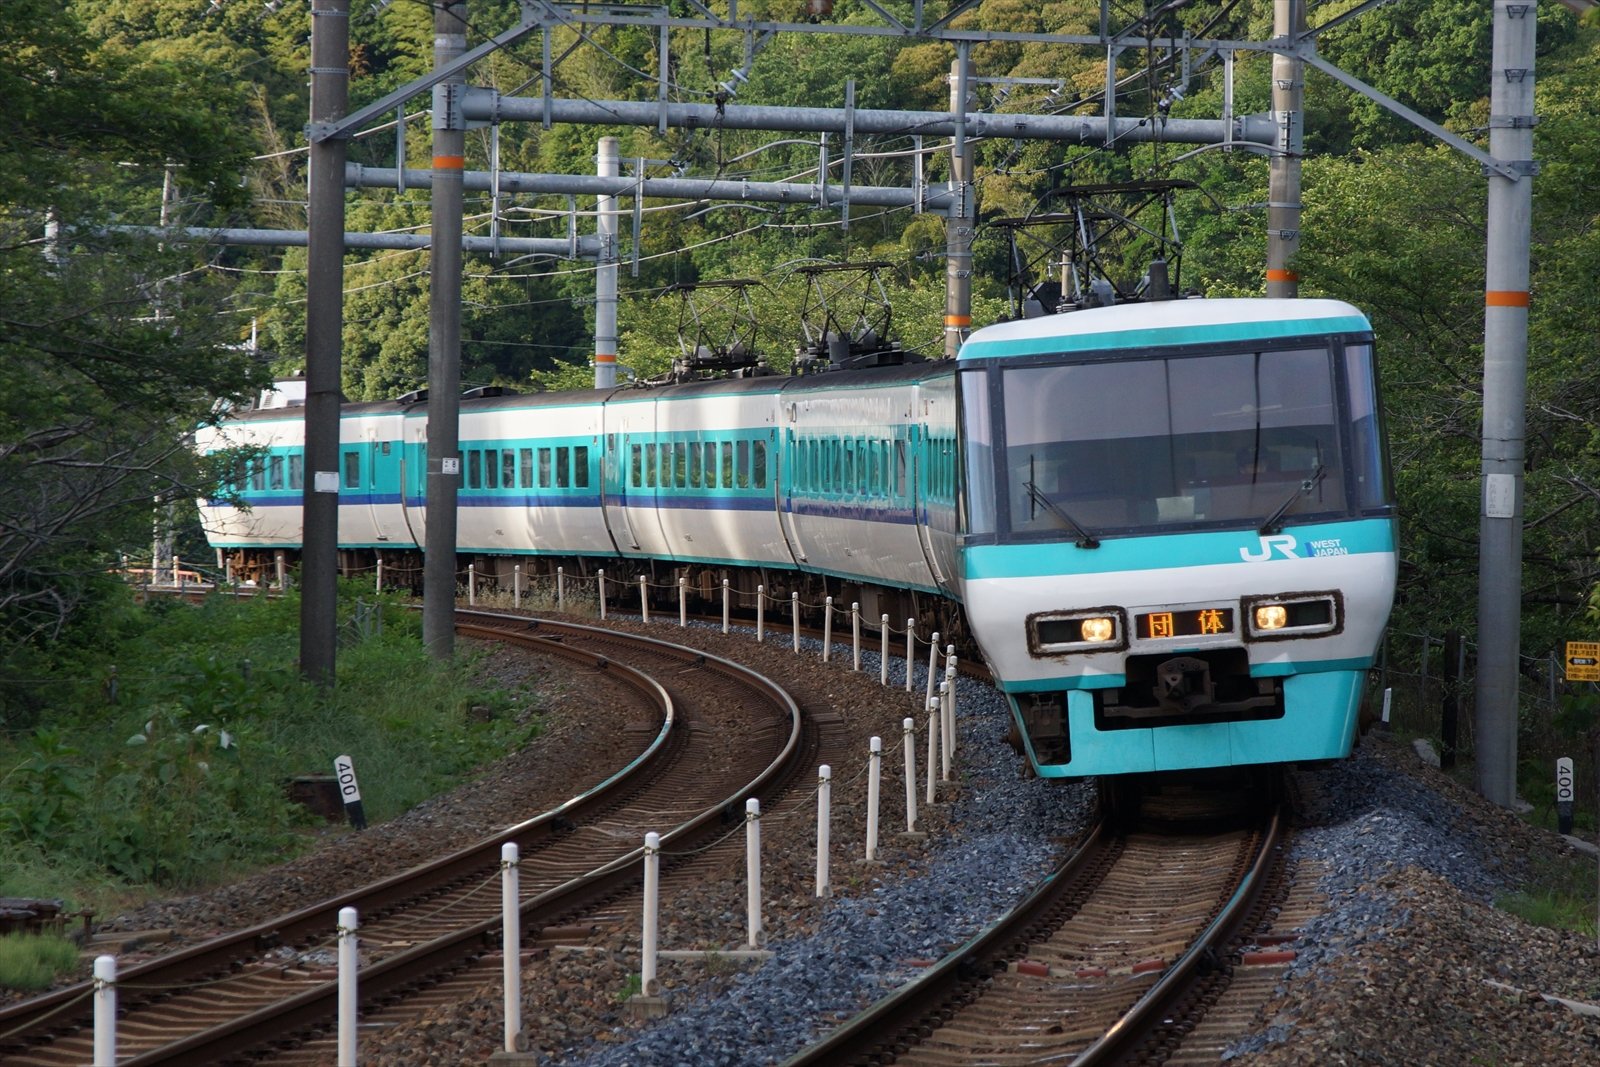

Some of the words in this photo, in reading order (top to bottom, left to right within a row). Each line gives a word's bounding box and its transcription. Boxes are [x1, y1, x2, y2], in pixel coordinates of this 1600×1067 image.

[1240, 535, 1297, 562] JR
[1310, 539, 1341, 549] WEST
[1313, 547, 1348, 557] JAPAN
[338, 763, 356, 796] 400
[1559, 765, 1571, 798] 400
